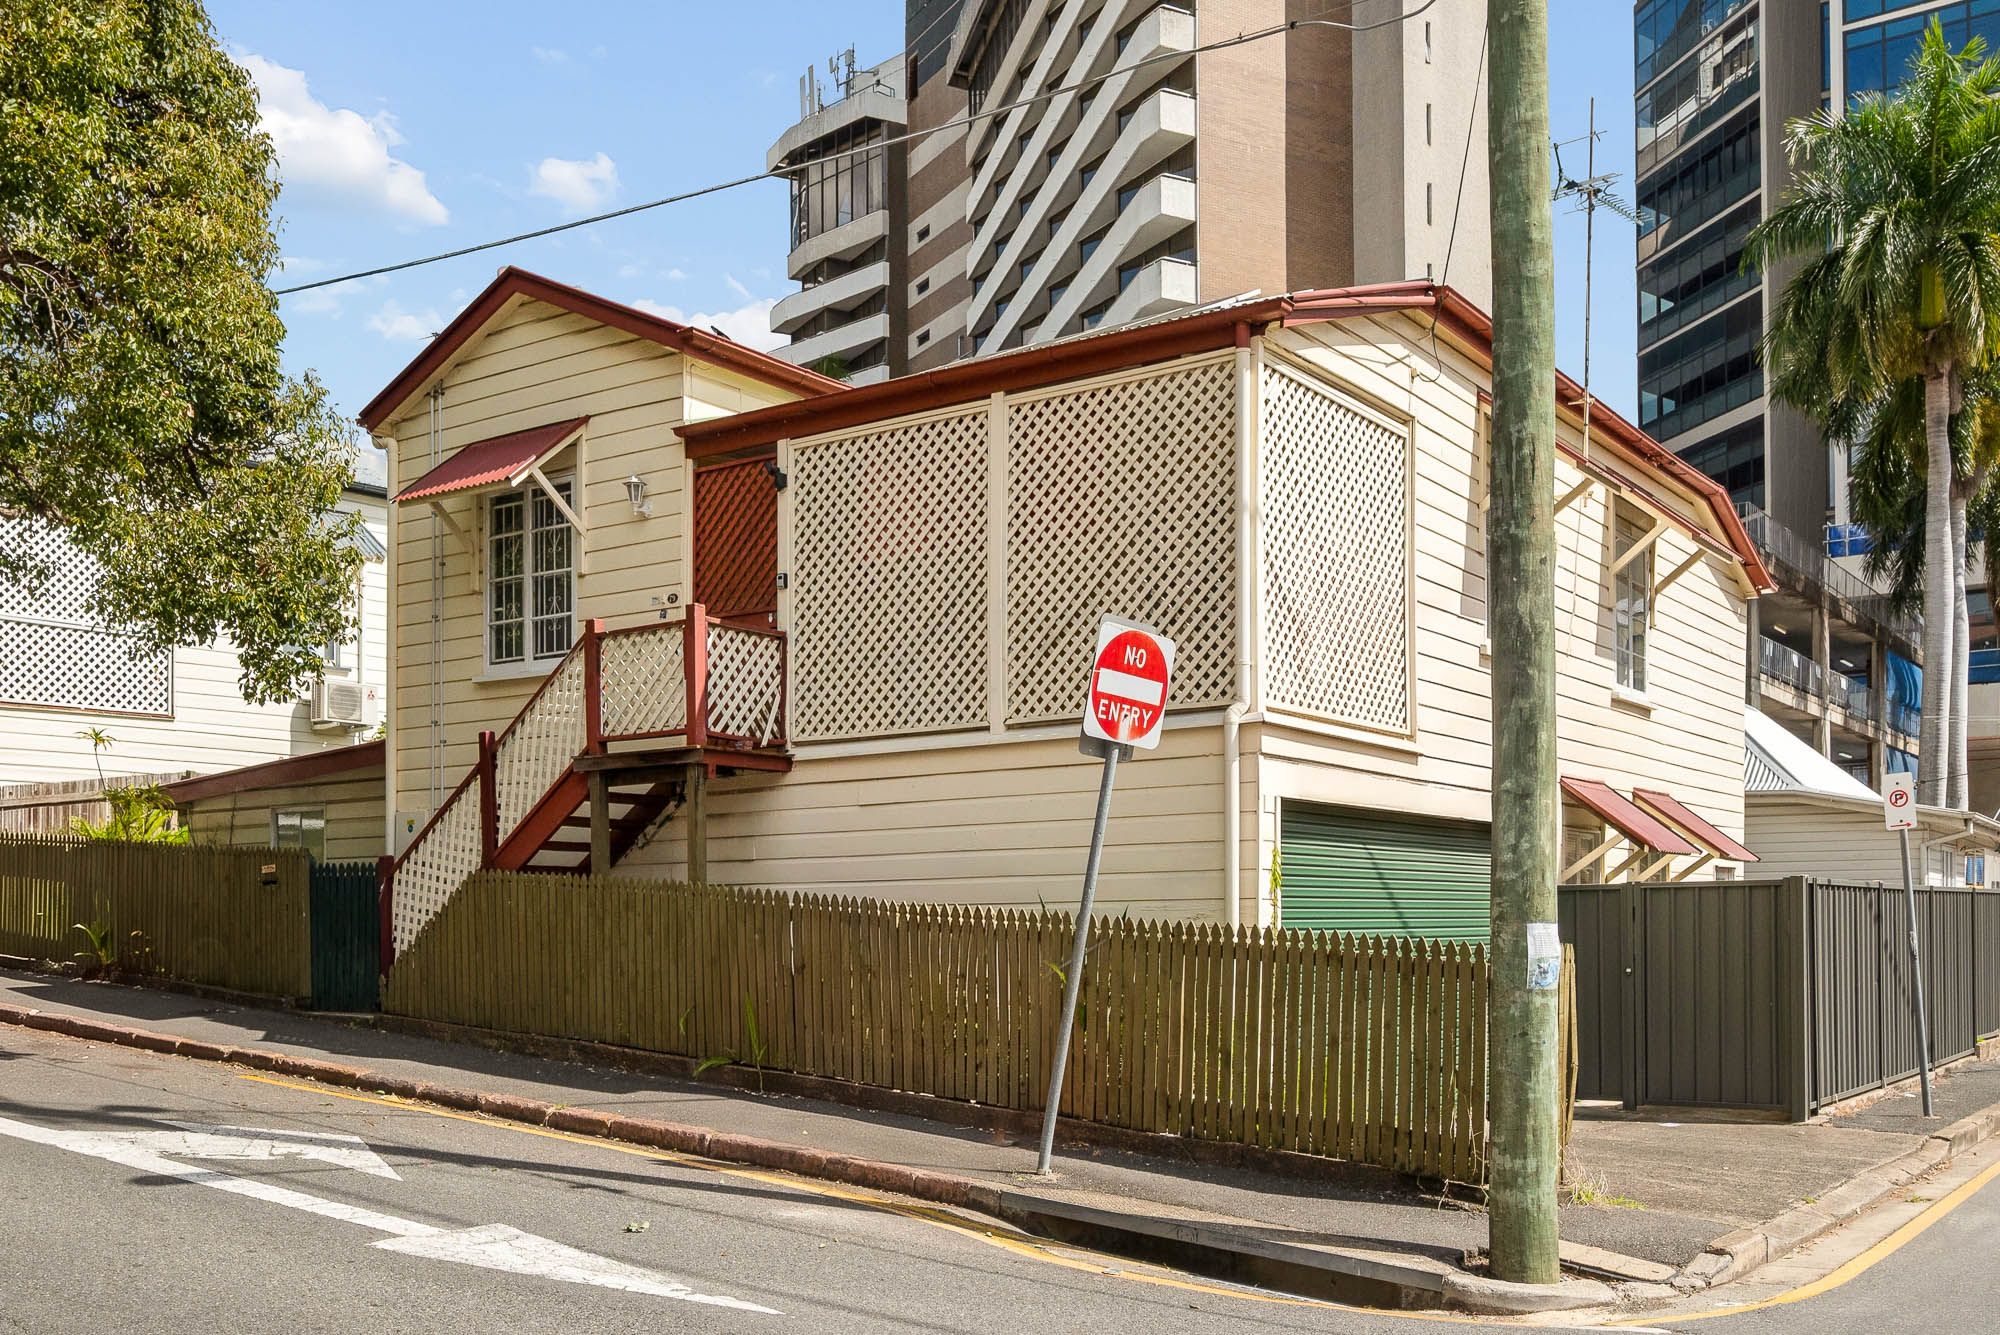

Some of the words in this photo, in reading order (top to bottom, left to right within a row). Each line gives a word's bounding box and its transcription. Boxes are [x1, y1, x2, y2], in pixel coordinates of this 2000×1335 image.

[1124, 645, 1147, 668] NO
[1098, 699, 1153, 729] ENTRY
[1895, 793, 1904, 804] P
